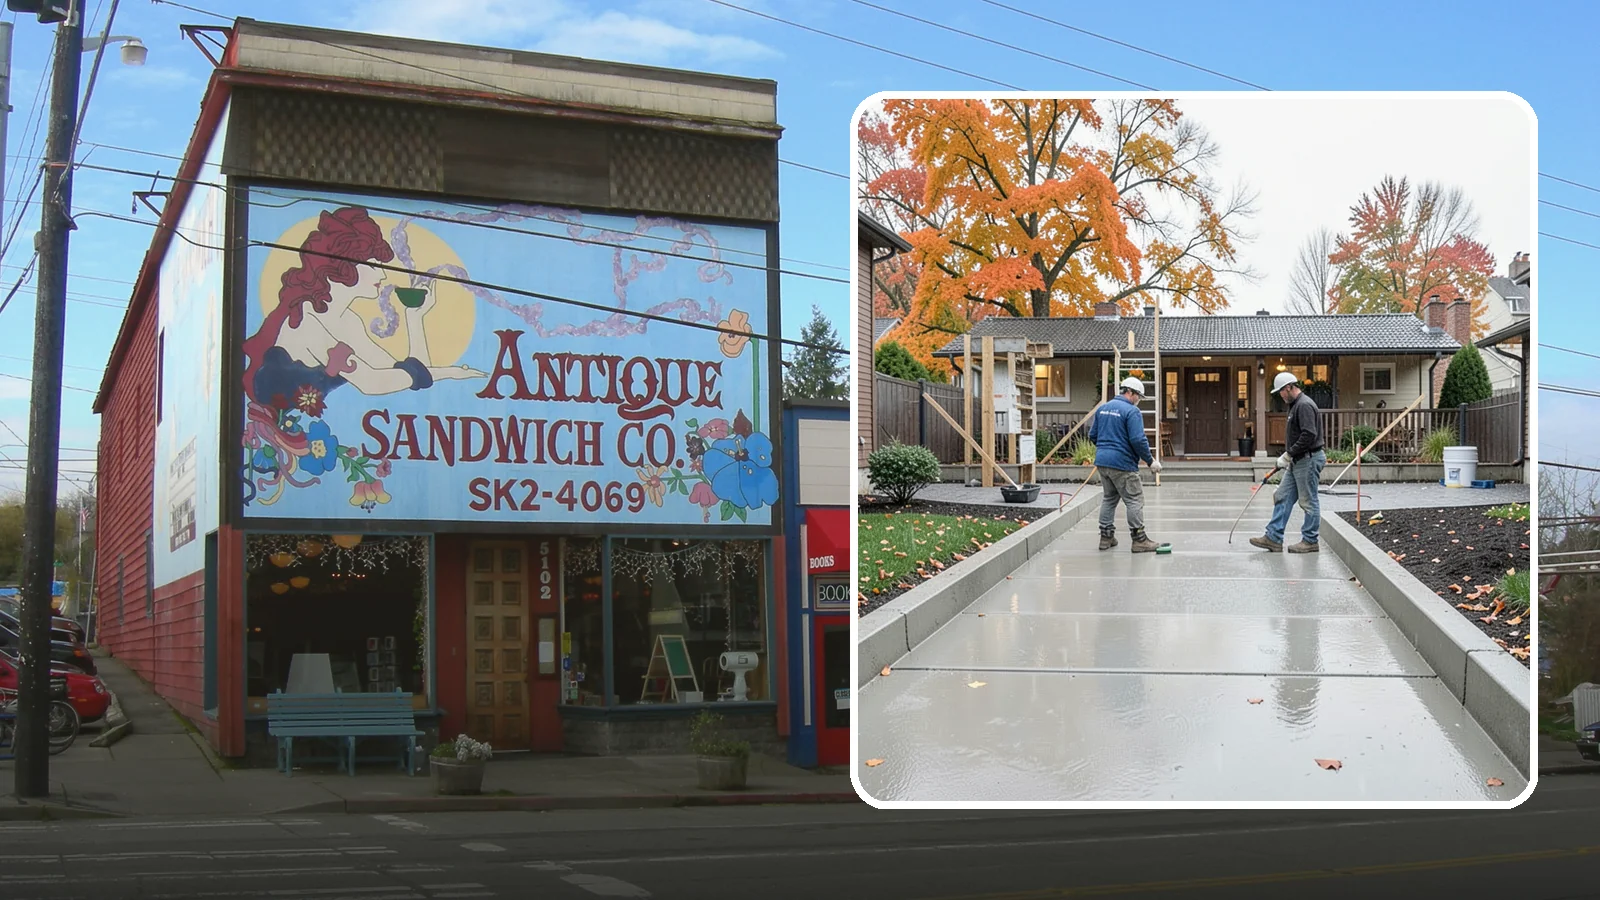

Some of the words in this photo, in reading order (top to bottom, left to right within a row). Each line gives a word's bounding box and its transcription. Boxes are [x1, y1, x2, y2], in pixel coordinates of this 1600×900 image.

[475, 329, 724, 421] ANTIQUE
[361, 408, 604, 467] SANDWICH
[617, 422, 685, 468] CO.
[468, 477, 645, 513] SK2-4069
[540, 542, 551, 599] 5102
[809, 555, 835, 569] BOOKS
